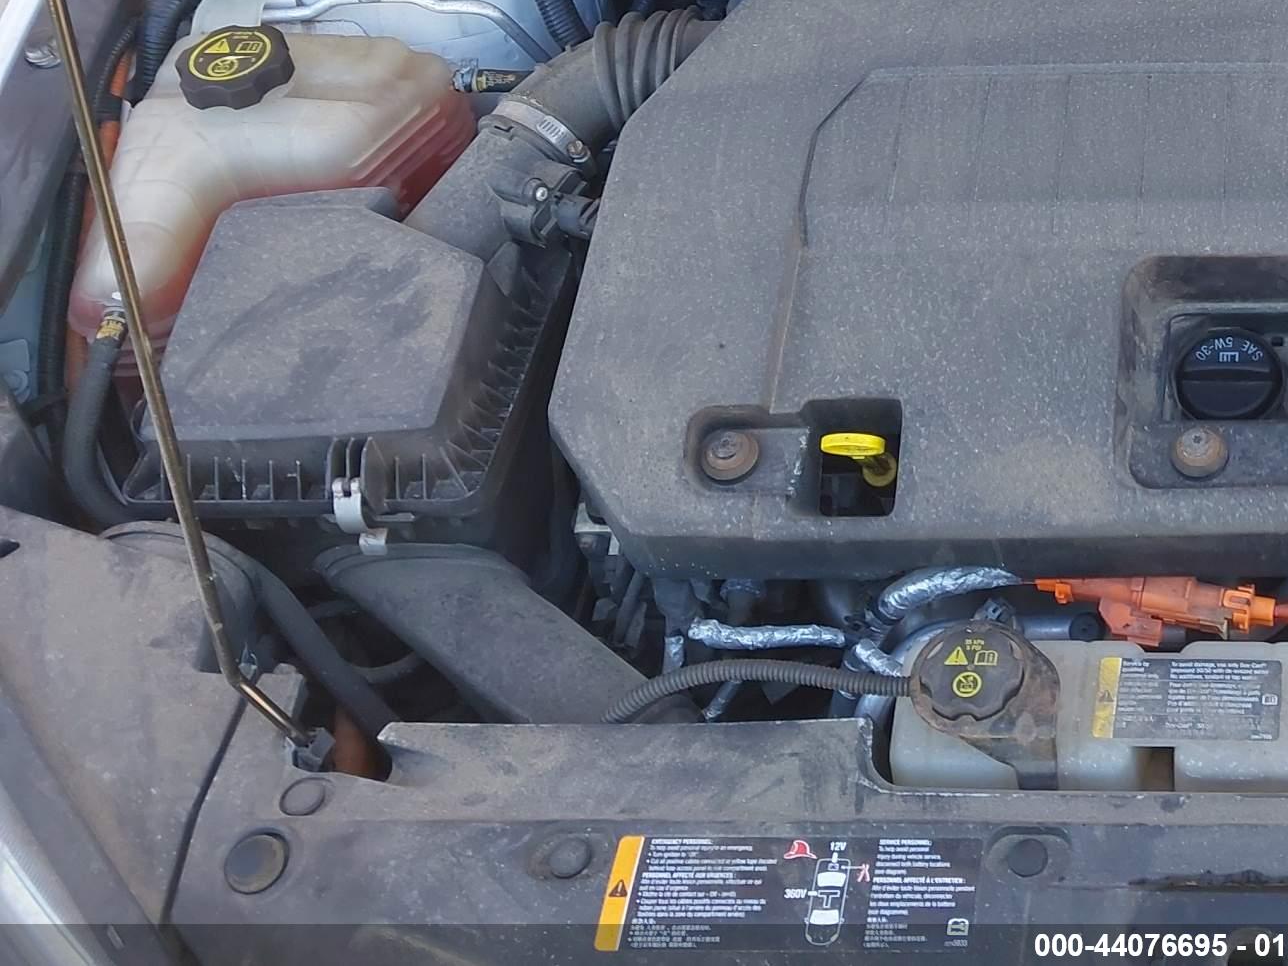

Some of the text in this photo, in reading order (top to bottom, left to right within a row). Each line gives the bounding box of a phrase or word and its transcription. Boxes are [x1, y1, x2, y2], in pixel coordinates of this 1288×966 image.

[1195, 336, 1264, 362] SAE 5W-30
[830, 841, 847, 851] 12V
